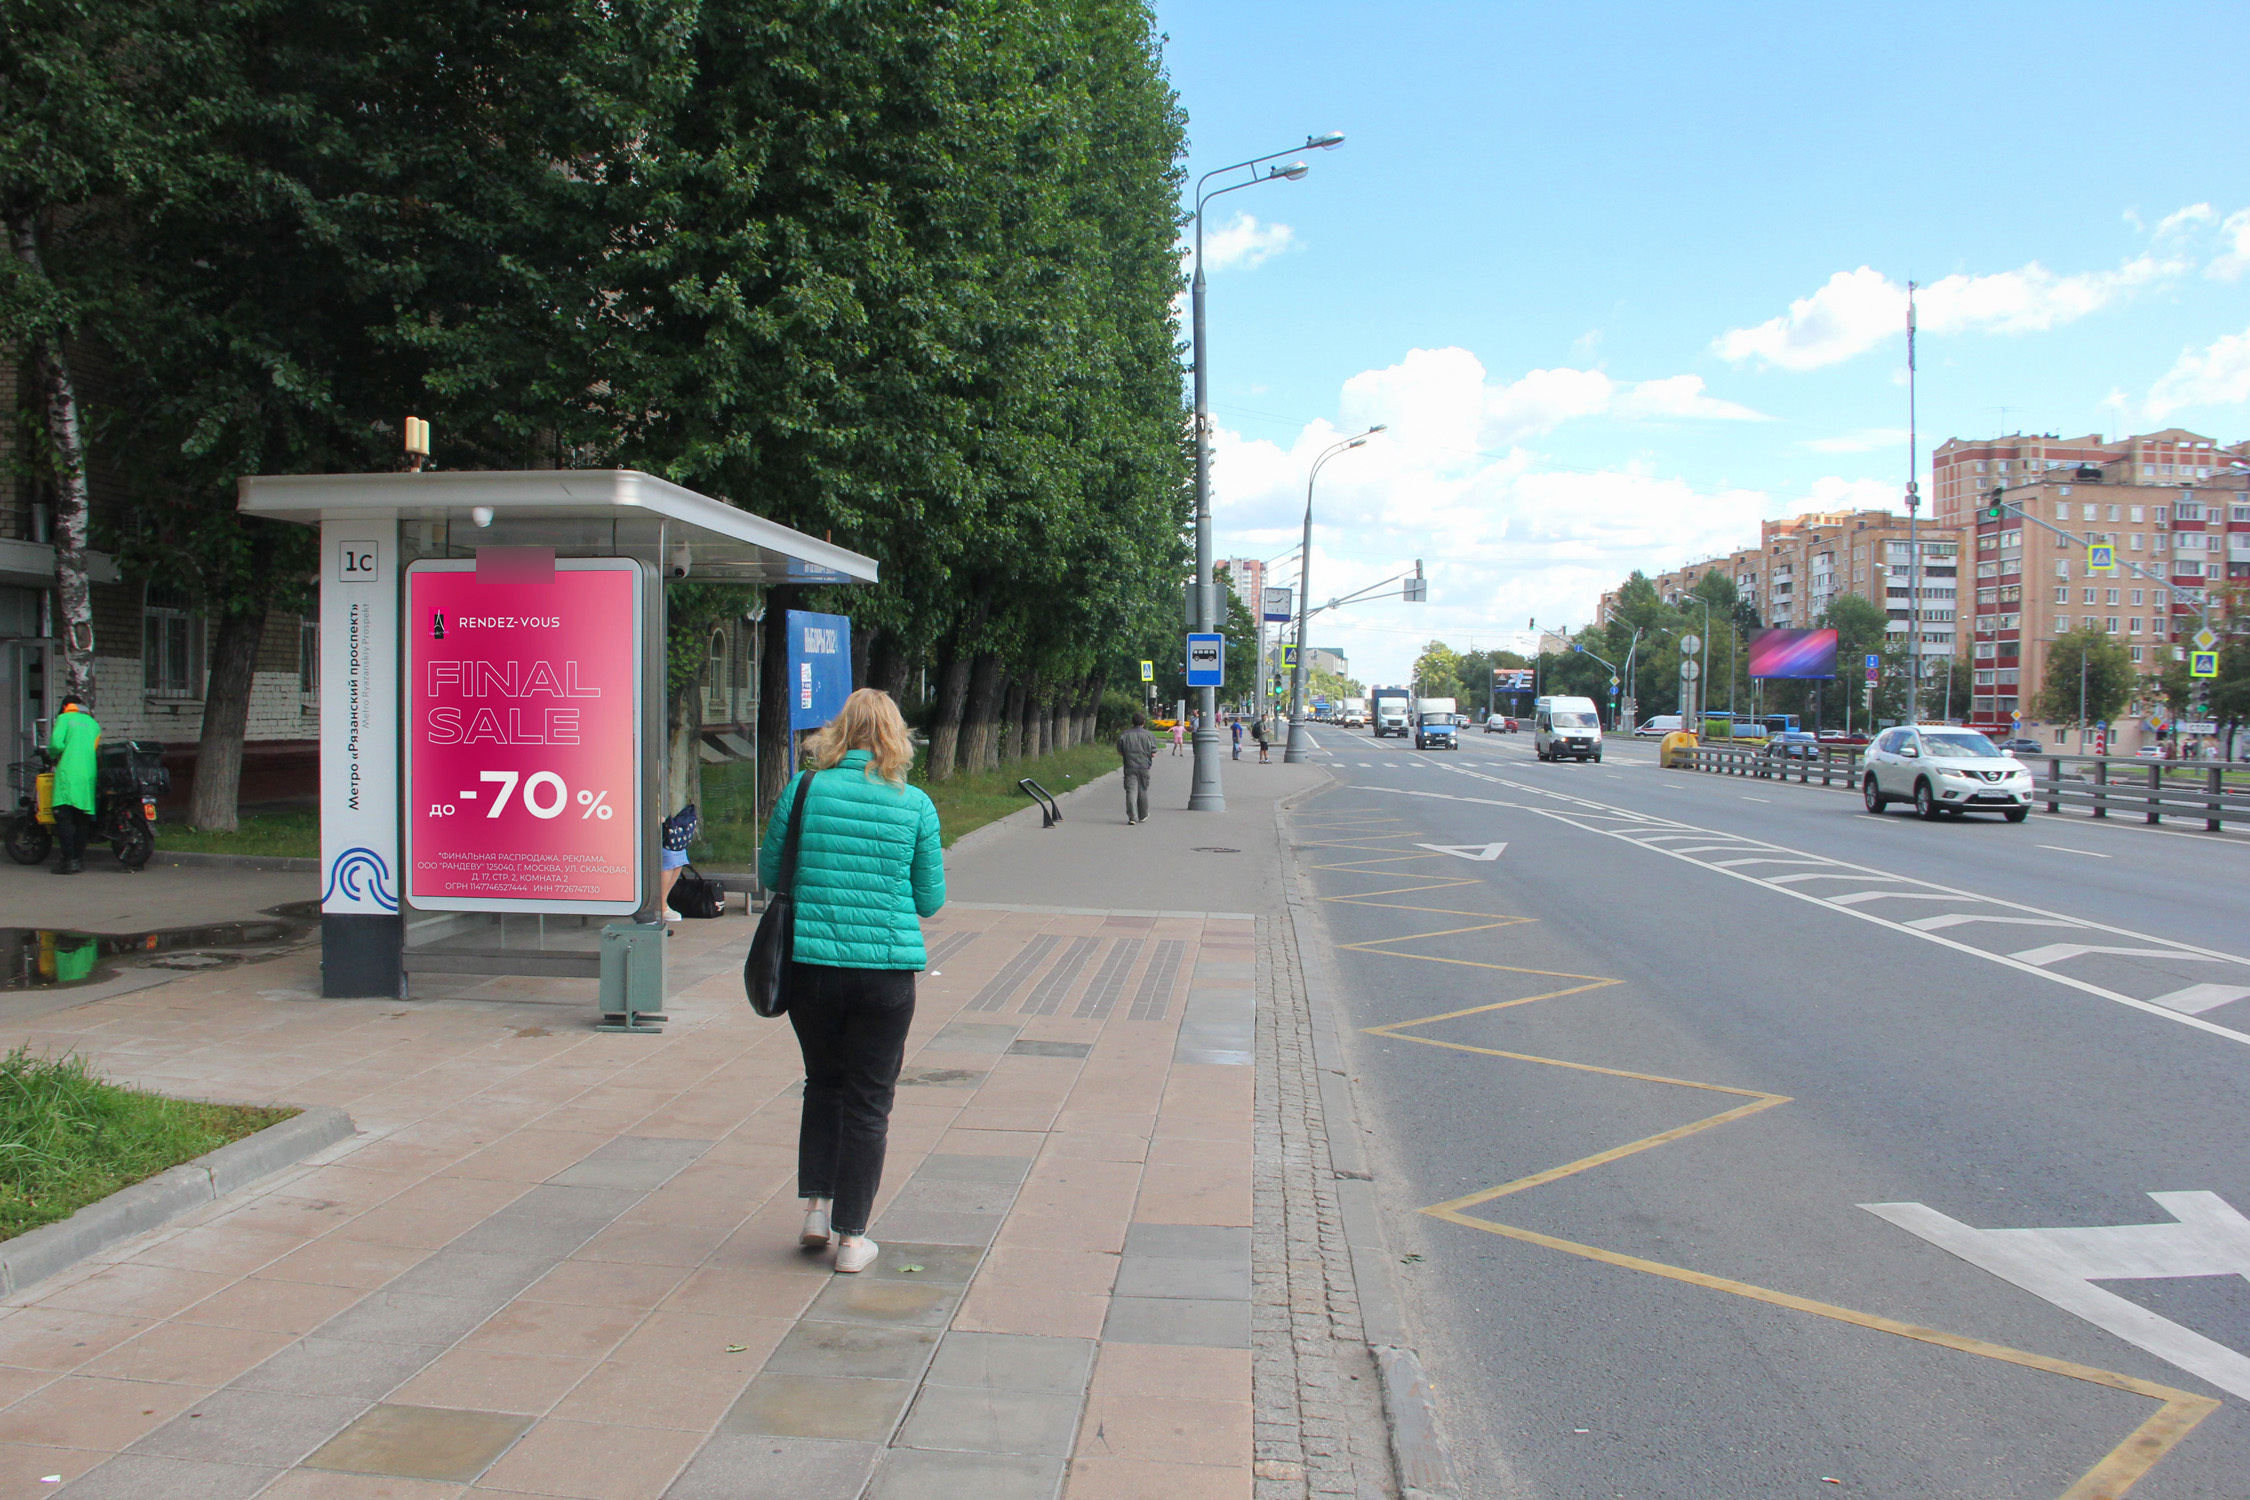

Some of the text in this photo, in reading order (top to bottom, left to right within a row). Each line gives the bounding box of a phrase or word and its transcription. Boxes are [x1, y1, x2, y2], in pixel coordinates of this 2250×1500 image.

[459, 616, 560, 628] RENDEZ-VOUS
[361, 603, 371, 729] Metro Ryazanskiy Prospekt
[428, 661, 601, 698] FINAL
[348, 603, 361, 811] Метро «Рязанский проспект»
[428, 707, 580, 745] SALE
[429, 804, 456, 818] до
[498, 853, 560, 863] РАСПРОДАЖА.
[562, 854, 606, 863] РЕКЛАМА.
[417, 861, 438, 870] ООО
[439, 861, 485, 871] "РАНДЕВУ"
[486, 863, 516, 872] 125040,
[524, 864, 563, 873] МОСКВА,
[564, 865, 578, 873] УЛ.
[579, 865, 629, 875] СКАКОВАЯ,
[471, 873, 569, 883] Д. 17, СТР. 2, КОМНАТА 2
[445, 882, 601, 894] ОГРН 1147746527444 ИНН 7726747130
